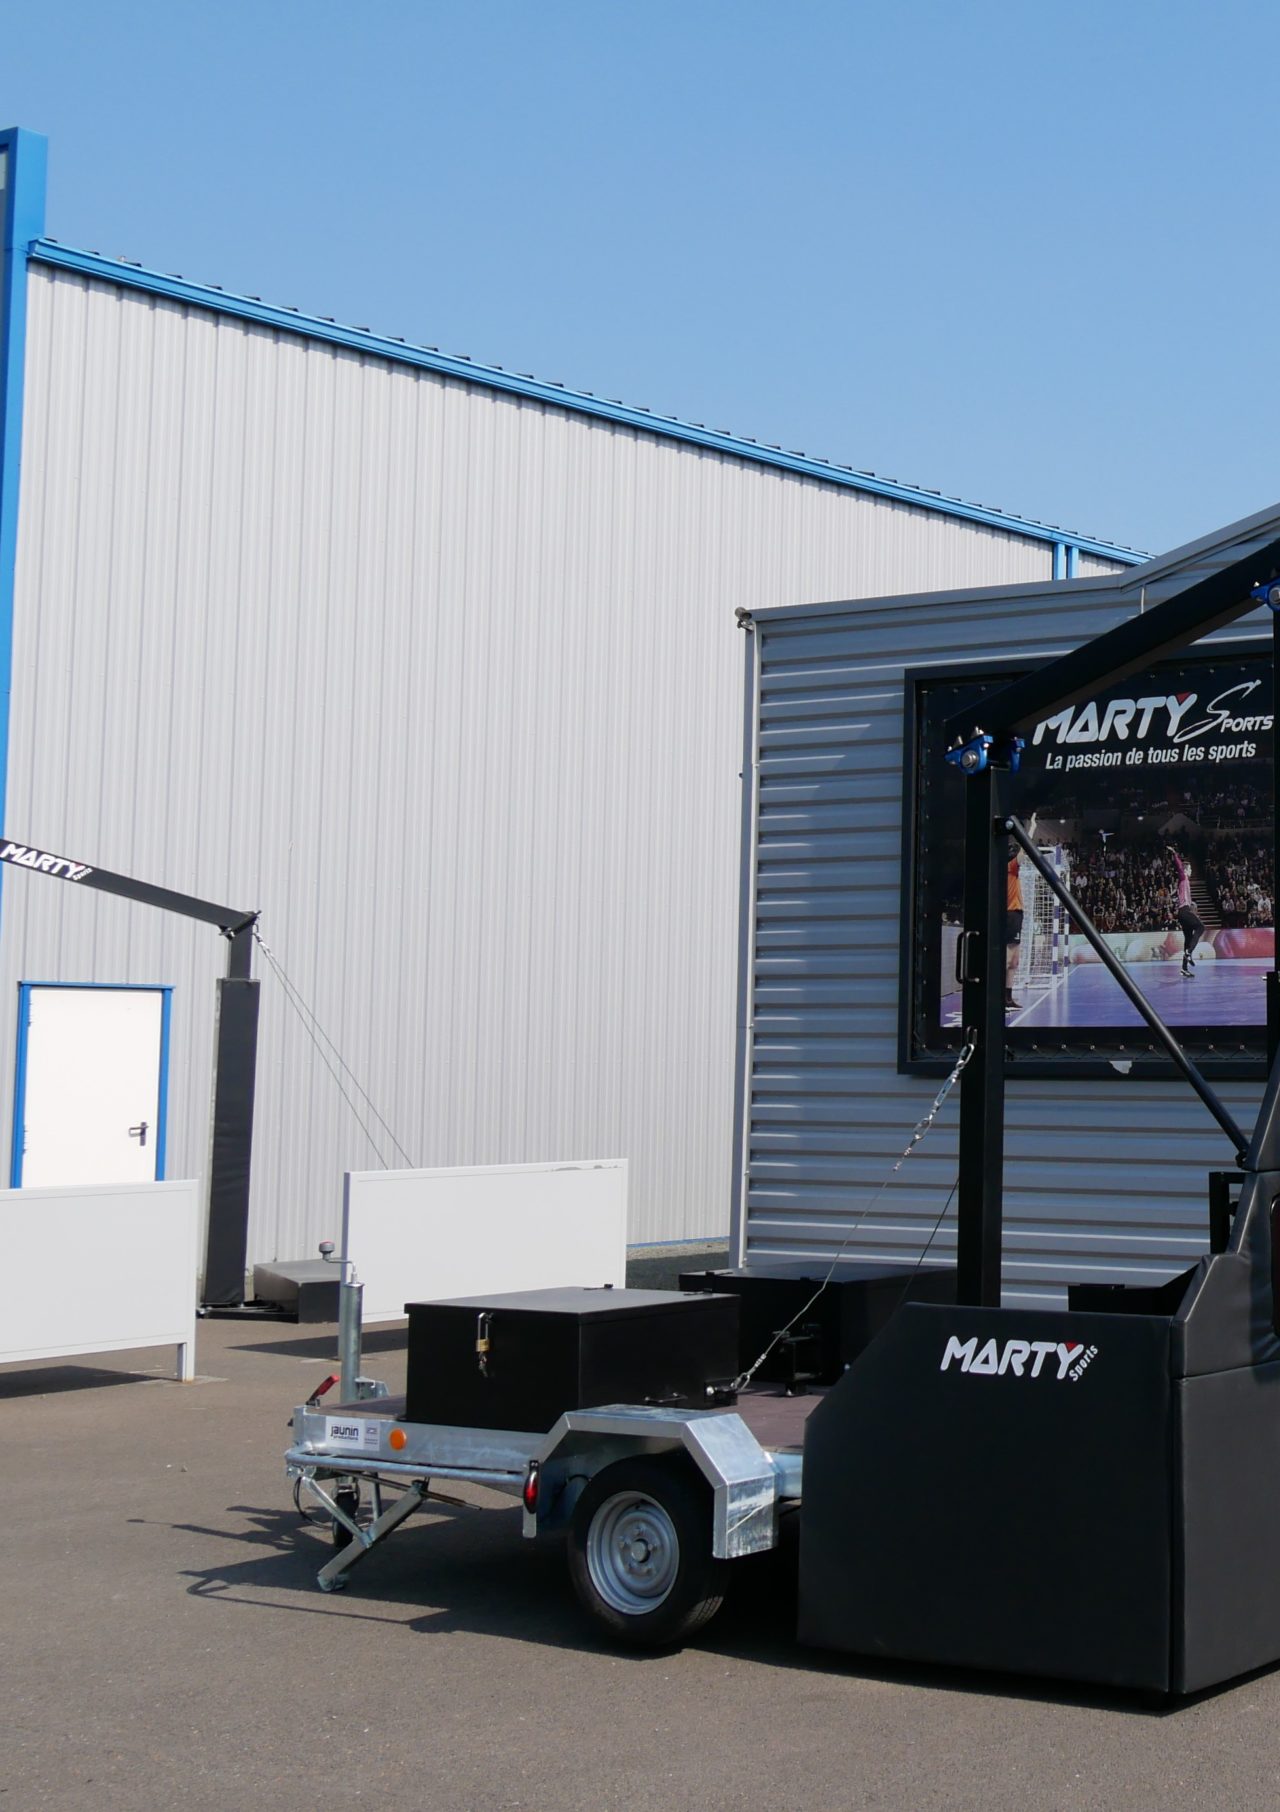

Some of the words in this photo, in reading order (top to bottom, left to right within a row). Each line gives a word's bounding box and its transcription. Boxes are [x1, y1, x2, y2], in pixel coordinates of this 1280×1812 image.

[1032, 692, 1198, 745] MARTY
[1045, 752, 1062, 769] La
[1066, 748, 1122, 772] passion
[1125, 747, 1143, 765] de
[1147, 748, 1179, 763] tous
[1183, 744, 1205, 761] les
[1208, 740, 1256, 763] sports
[0, 843, 87, 878] MARTY
[940, 1335, 1085, 1380] MARTY
[1068, 1344, 1099, 1382] Sports
[330, 1425, 359, 1437] jaunin
